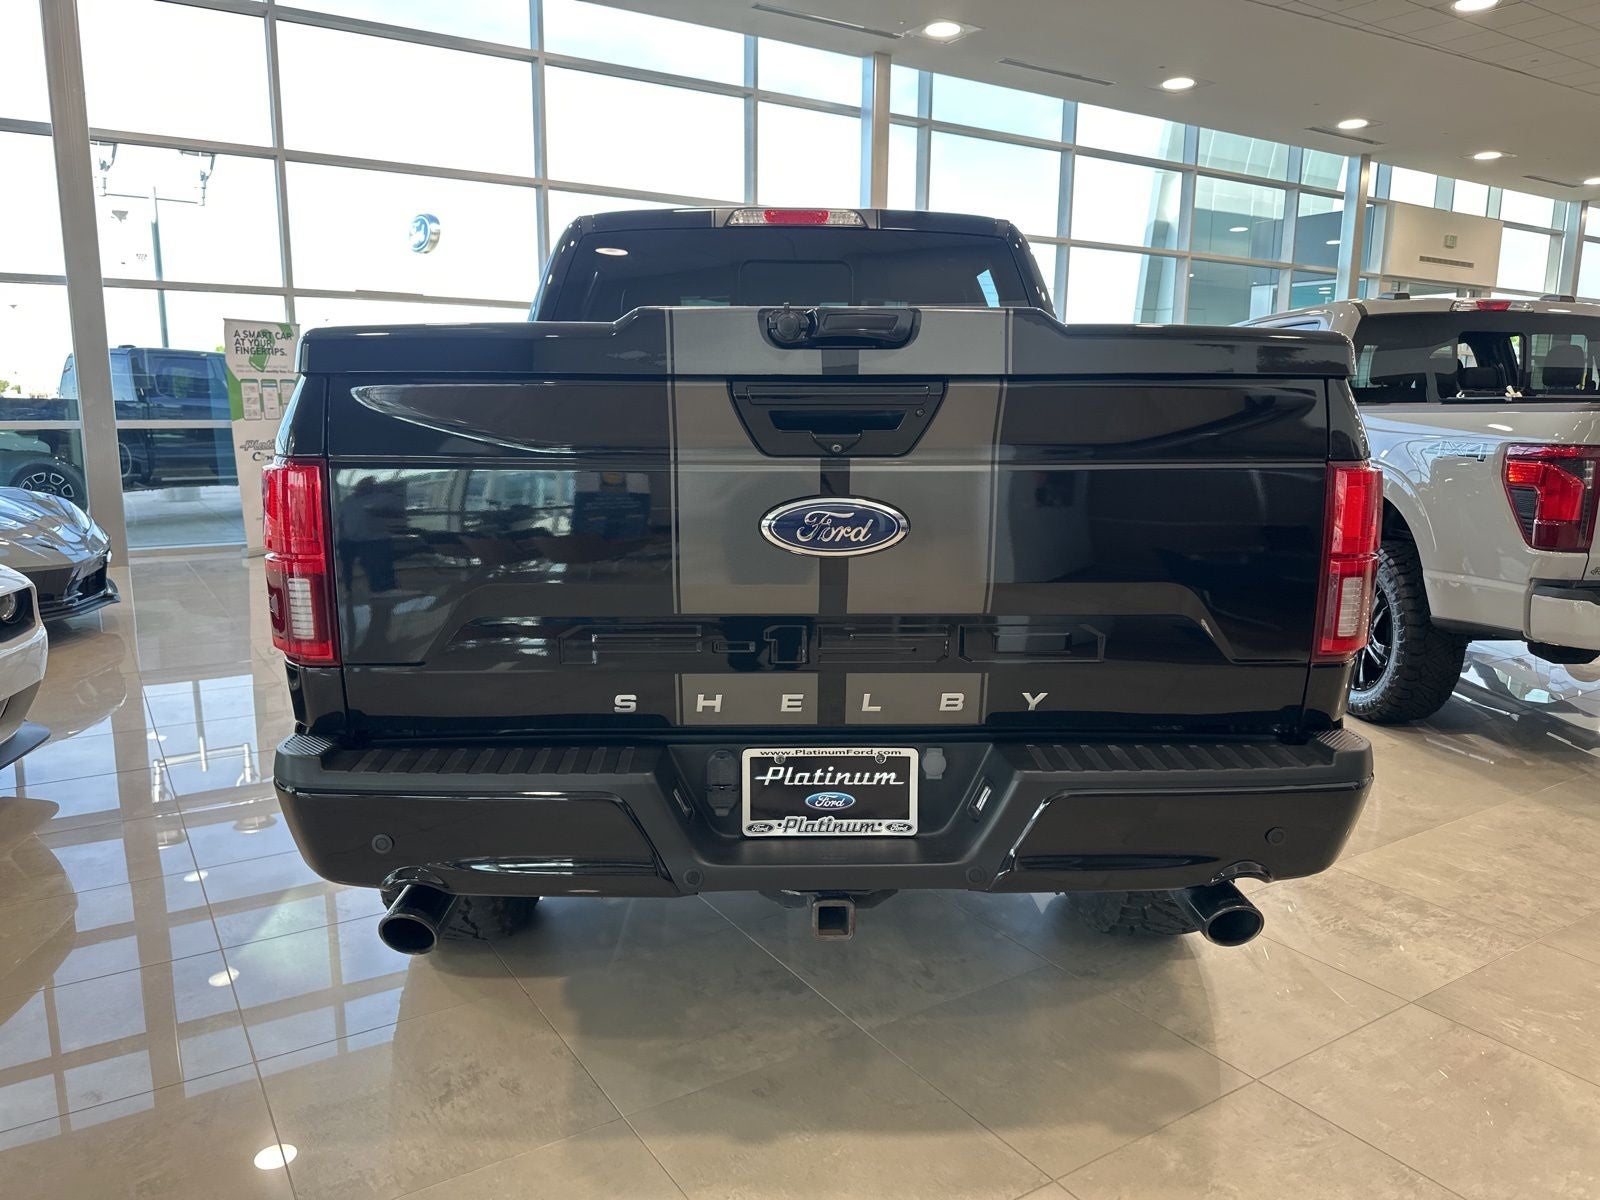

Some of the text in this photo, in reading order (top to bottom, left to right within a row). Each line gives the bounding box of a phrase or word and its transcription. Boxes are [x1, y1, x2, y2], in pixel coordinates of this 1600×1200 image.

[234, 329, 293, 340] A SMART CAR
[234, 338, 272, 347] AT YOUR
[235, 346, 288, 356] FINGERTIPS.
[239, 439, 275, 452] Plati
[796, 510, 874, 543] Ford
[613, 691, 1049, 713] SHELBY
[760, 748, 902, 757] www.PlatinumFord.com
[754, 765, 905, 786] Platinum
[814, 793, 845, 808] Ford
[780, 816, 882, 834] Platinum
